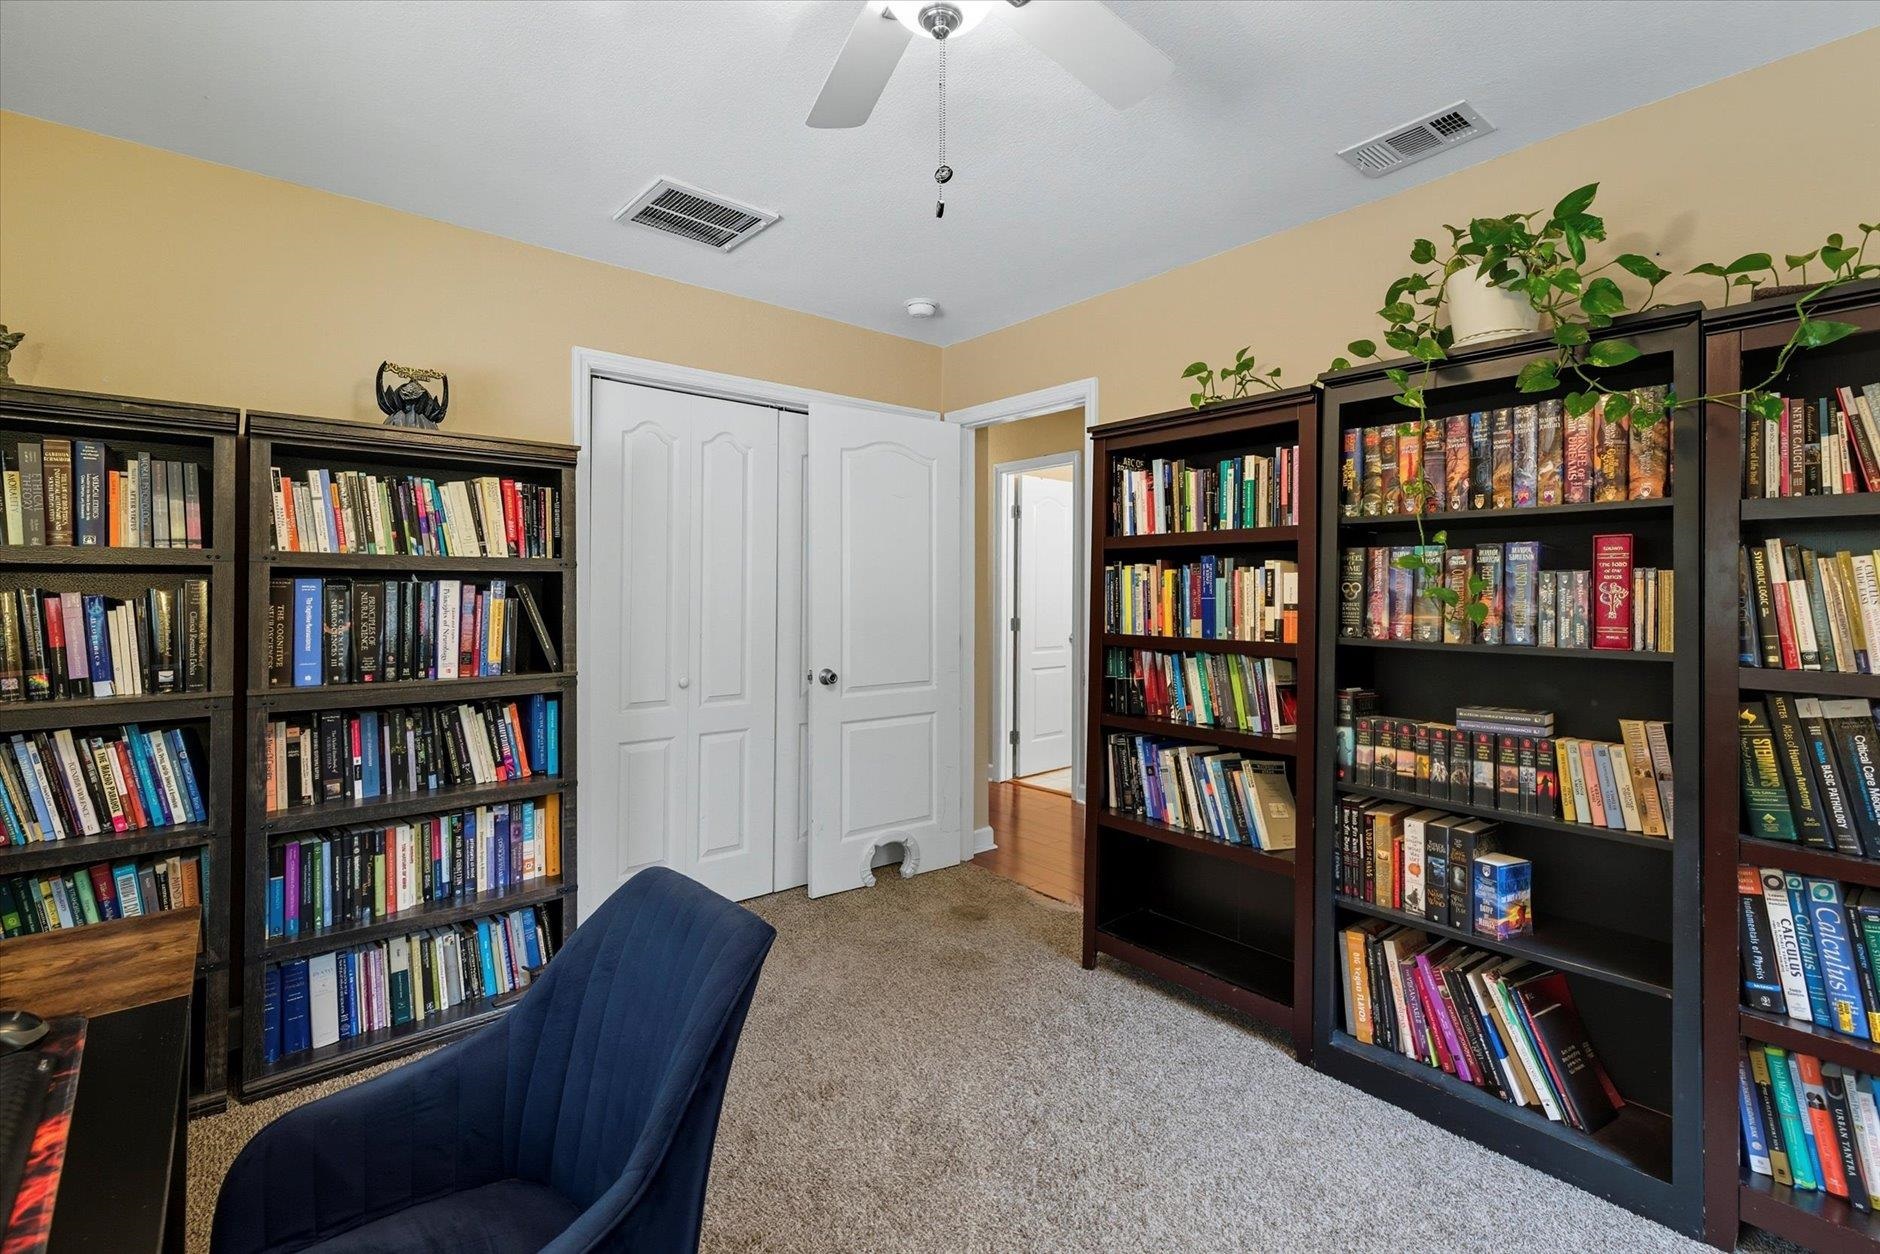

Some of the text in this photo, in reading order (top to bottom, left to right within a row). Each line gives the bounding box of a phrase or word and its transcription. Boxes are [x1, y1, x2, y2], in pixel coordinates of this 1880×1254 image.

[1750, 421, 1758, 431] The
[1792, 407, 1803, 474] NEVER CAUGHT
[1750, 432, 1760, 452] Politics
[1568, 436, 1578, 481] DREAMS
[1577, 439, 1587, 480] KNIFE OF
[1751, 460, 1759, 471] Life
[8, 474, 19, 512] MORALITY
[22, 474, 33, 511] THEORY
[33, 473, 44, 512] ETHICAL
[1751, 471, 1759, 486] Itself
[1515, 563, 1528, 586] WIND
[1754, 551, 1769, 606] SYMBOLIC LOGIC
[1855, 566, 1867, 606] MADE EASY
[1865, 565, 1879, 605] CALCULUS
[443, 588, 452, 618] Principles
[1512, 599, 1528, 626] TRUTH
[189, 611, 198, 676] Clinical Research Ethics
[276, 604, 285, 667] THE COGNITIVE
[369, 636, 376, 647] OF
[440, 629, 450, 661] Neurology
[97, 752, 106, 764] THE
[1752, 739, 1781, 788] STEDMAN'S
[1775, 697, 1813, 811] NETTER Atlas of Human Anatomy
[1854, 735, 1874, 764] Critical
[101, 765, 112, 787] MACHO
[1744, 759, 1756, 787] Dictionary
[1821, 764, 1836, 787] BASIC
[1863, 766, 1877, 787] Care
[76, 789, 90, 818] VIOLENCE
[107, 787, 121, 814] PARADOX
[1827, 787, 1848, 829] PATHOLOGY
[1366, 856, 1374, 877] CHAOS
[172, 877, 182, 899] MIND
[362, 882, 370, 896] Mind
[1742, 897, 1765, 980] Fundamentals of Physics
[1781, 918, 1802, 978] CALCULUS
[1794, 914, 1818, 970] Calculus
[1815, 907, 1851, 991] Calculus
[1353, 952, 1361, 964] BIG
[1356, 993, 1366, 1023] FLAVOR
[1407, 976, 1416, 1001] VEGAN
[1412, 1002, 1422, 1024] TABLE
[1777, 1081, 1786, 1091] Me
[1779, 1092, 1794, 1112] Tight
[1835, 1108, 1857, 1176] URBAN TANTRA
